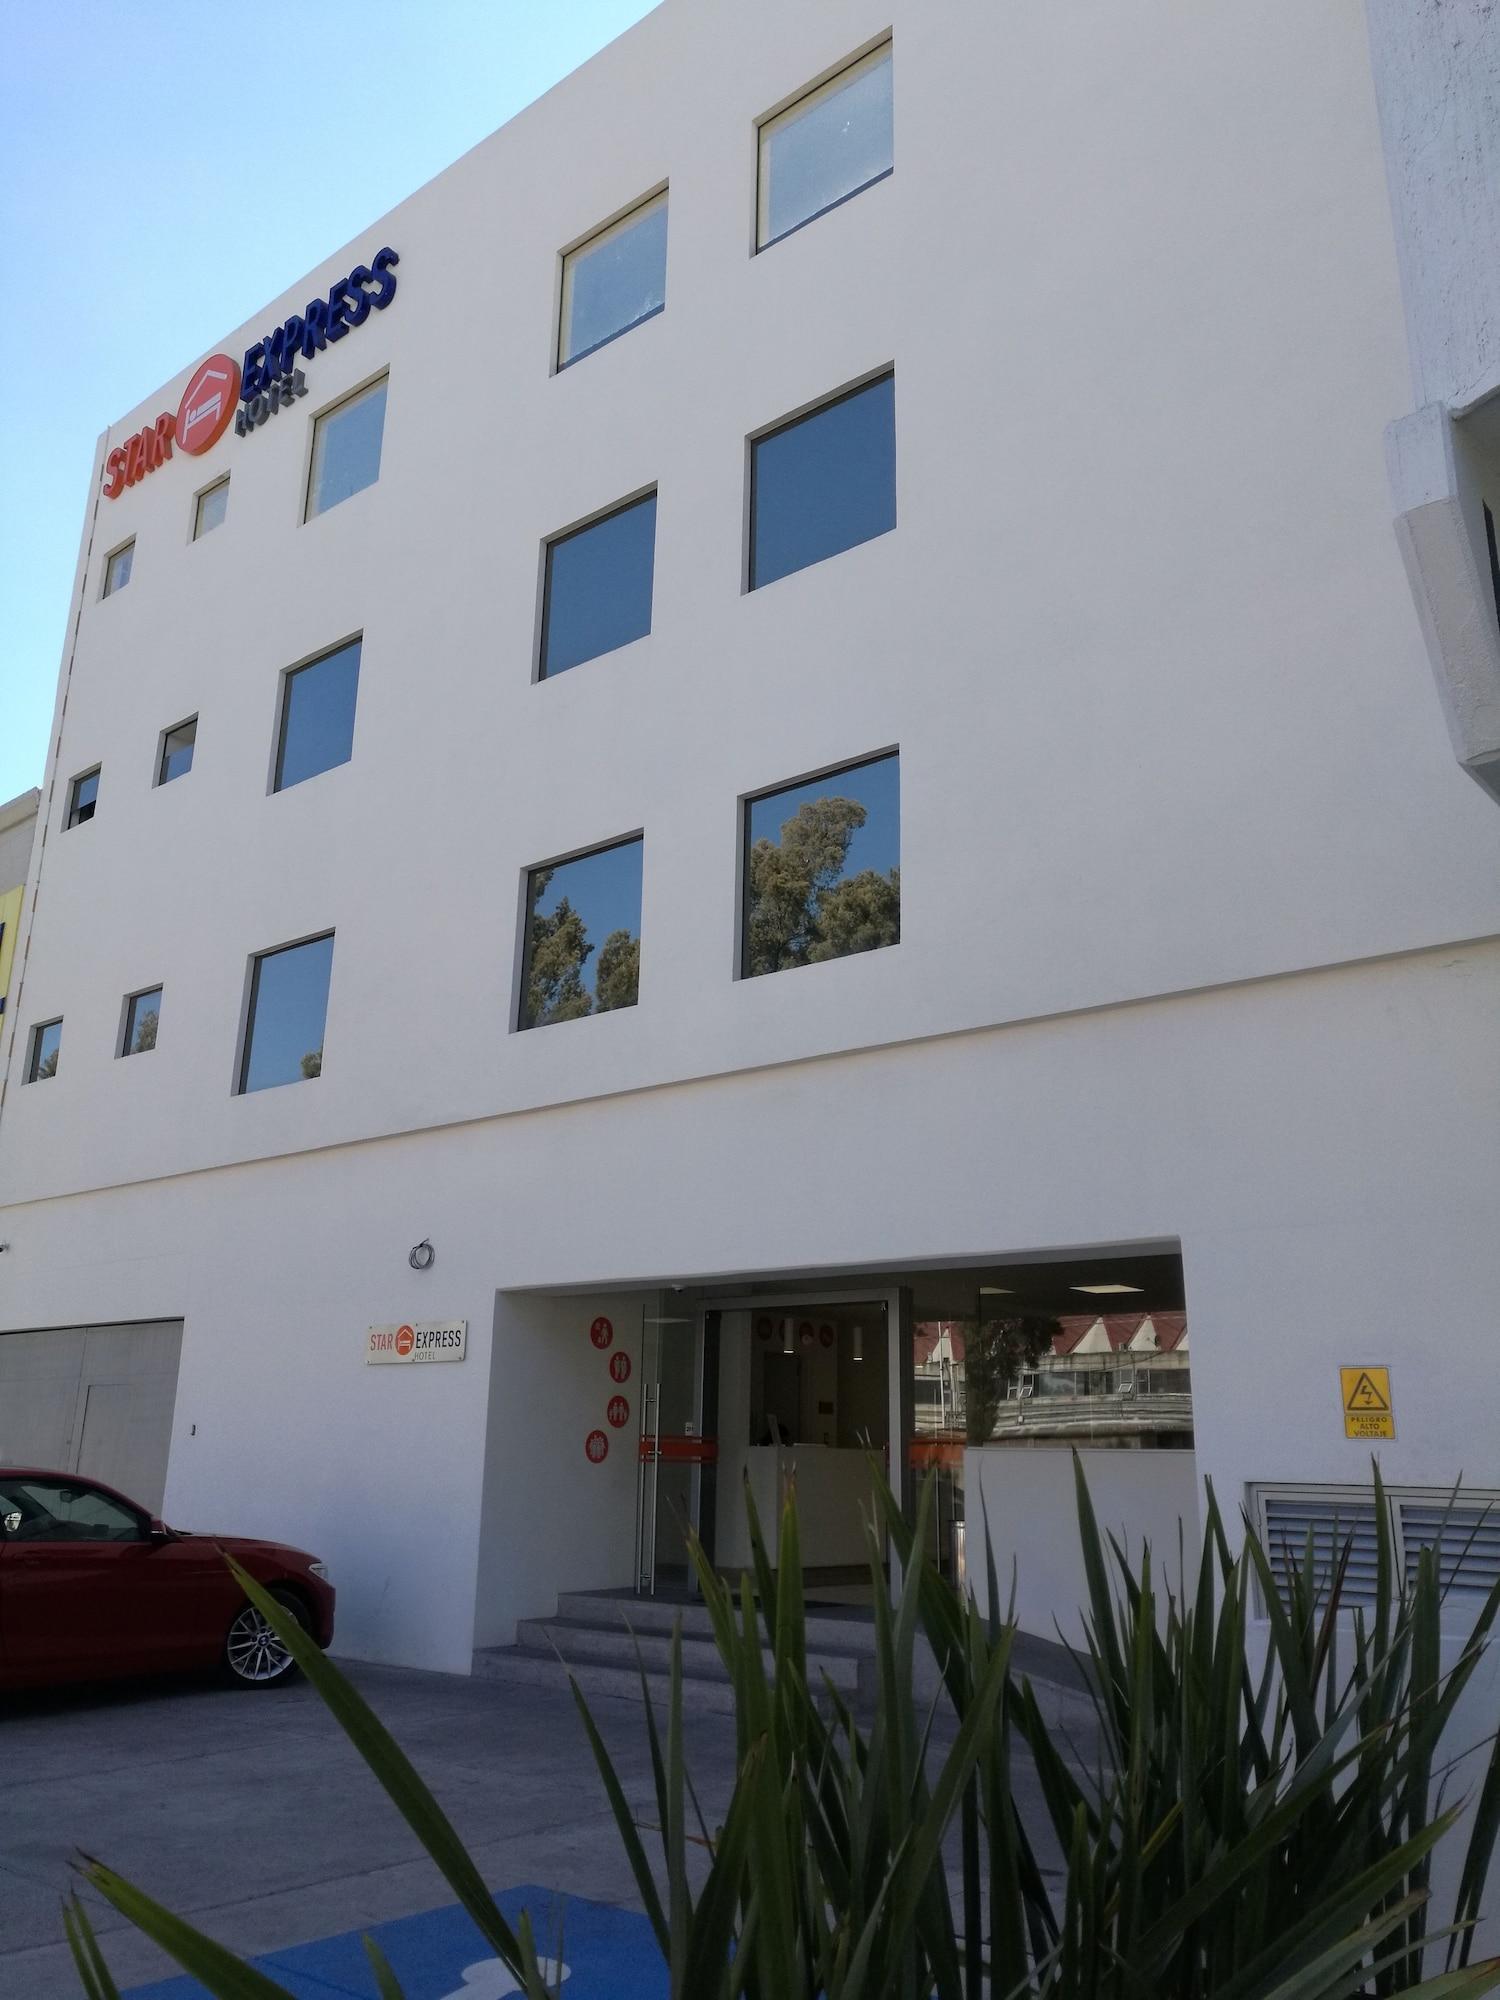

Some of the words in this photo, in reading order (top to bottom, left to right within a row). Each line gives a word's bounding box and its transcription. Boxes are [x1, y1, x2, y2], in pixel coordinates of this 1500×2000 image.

[102, 411, 177, 500] STAR
[239, 246, 400, 403] EXPRESS
[234, 368, 309, 438] HOTEL
[370, 1333, 393, 1351] STAR
[415, 1330, 462, 1349] EXPRESS
[414, 1351, 436, 1360] HOTEL
